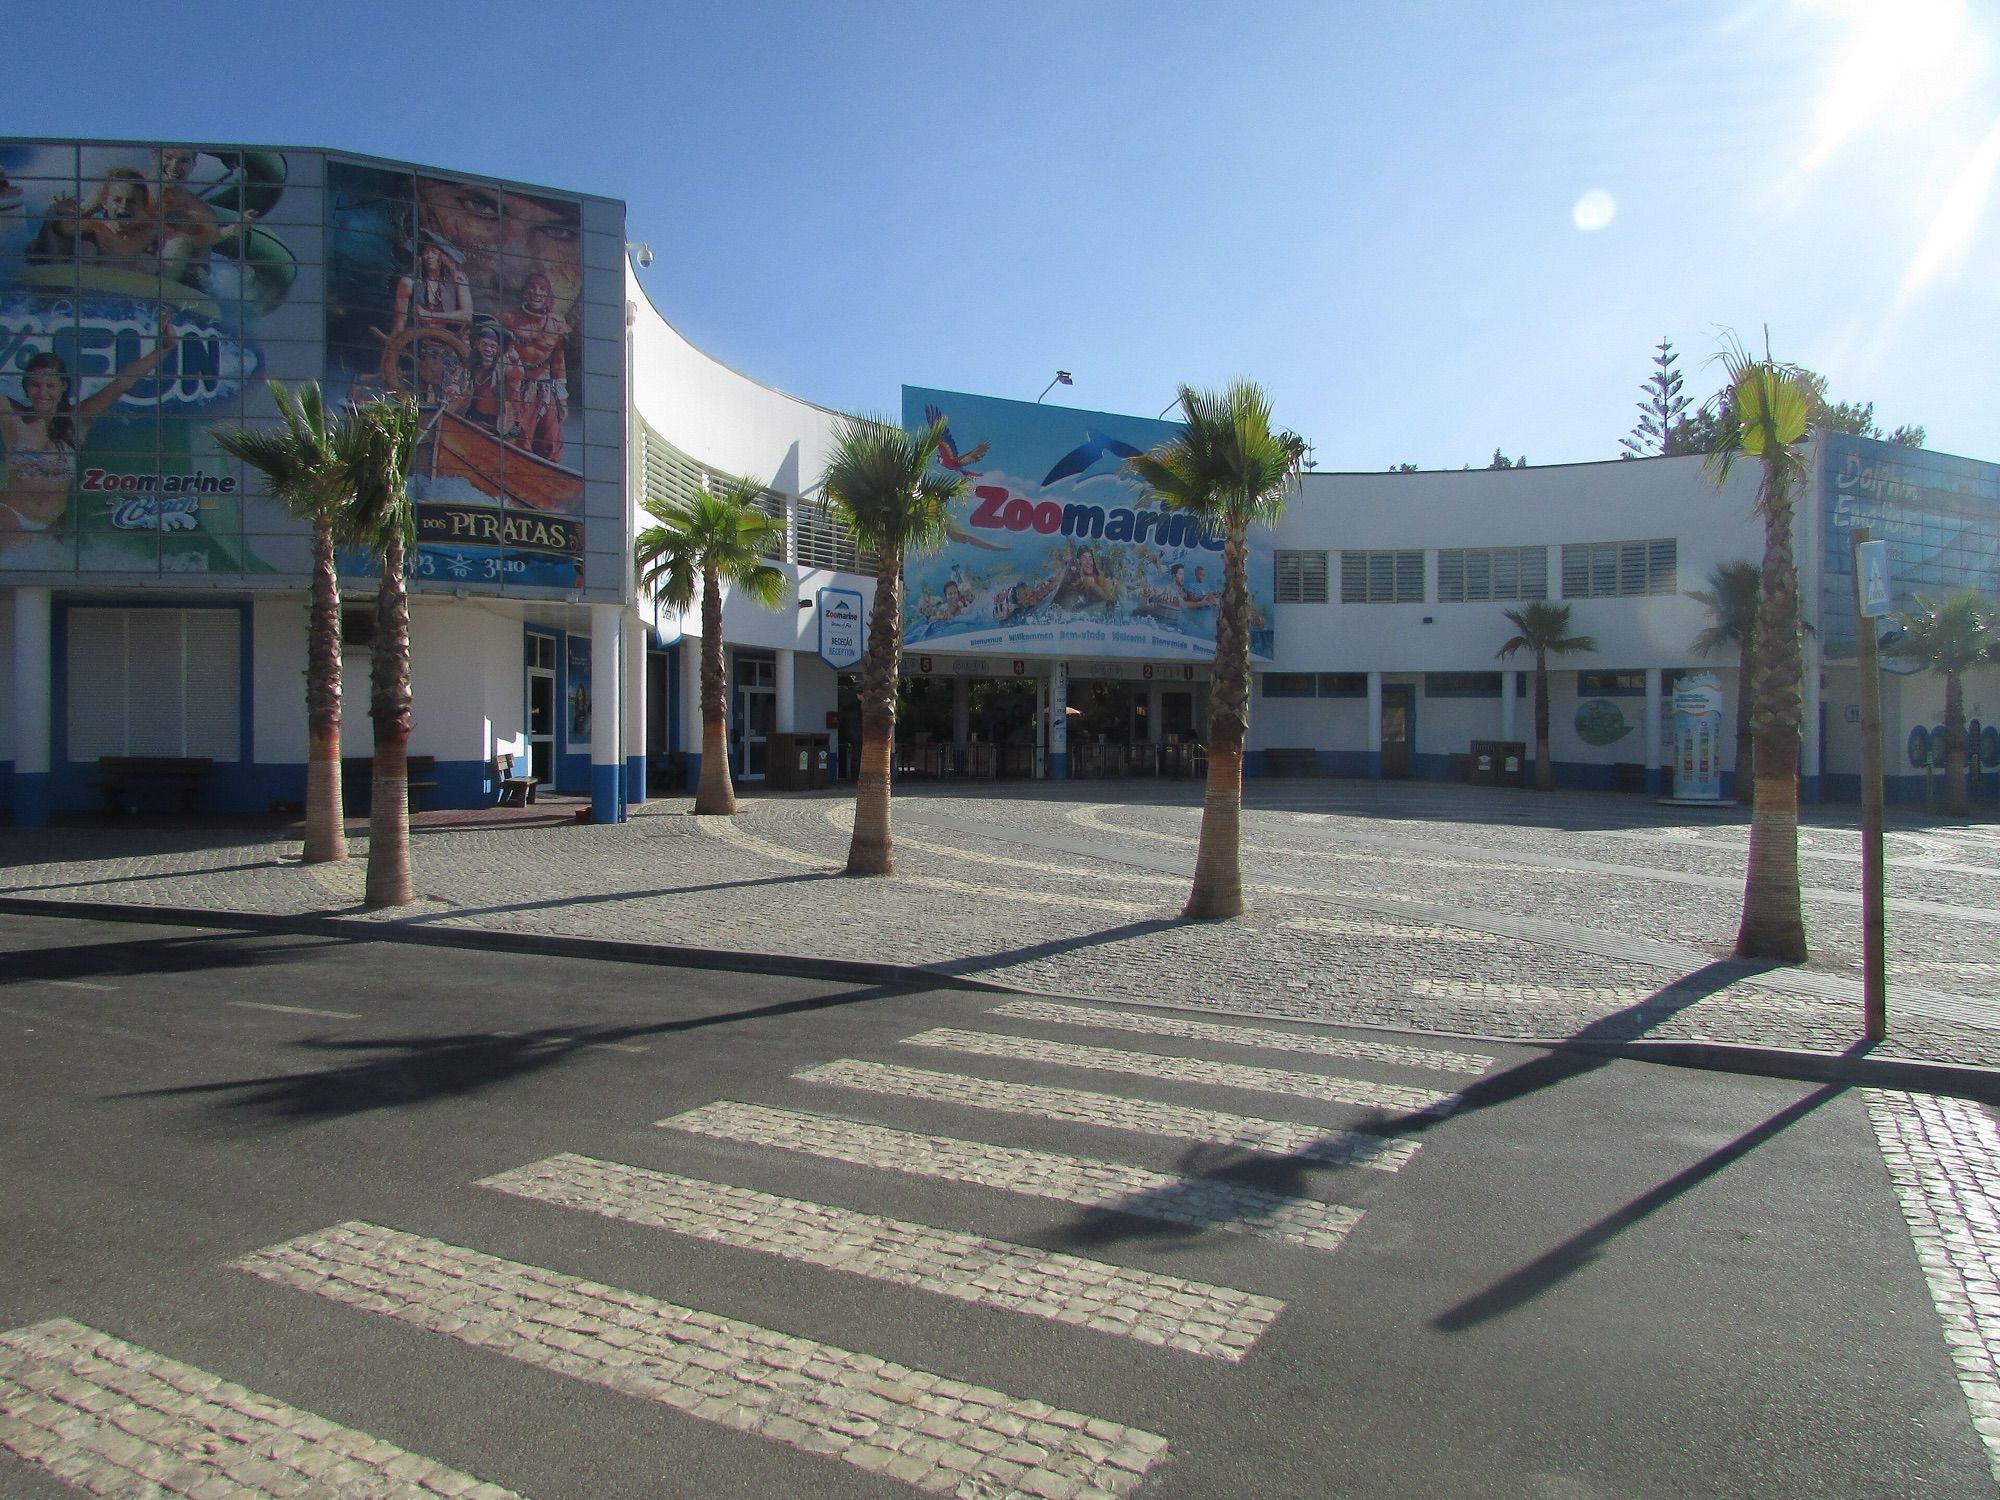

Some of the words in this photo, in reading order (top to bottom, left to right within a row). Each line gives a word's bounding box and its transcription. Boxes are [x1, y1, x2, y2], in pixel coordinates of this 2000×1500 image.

[52, 325, 220, 401] FUN
[82, 469, 236, 493] Zoomarine
[1838, 452, 1919, 502] Dolphin
[423, 518, 446, 530] DOS
[446, 511, 566, 548] PIRATAS
[1059, 629, 1106, 641] Bem-vindo
[1111, 631, 1147, 644] Welcome
[922, 658, 930, 670] 5
[1015, 661, 1023, 673] 4
[1145, 667, 1151, 678] 2
